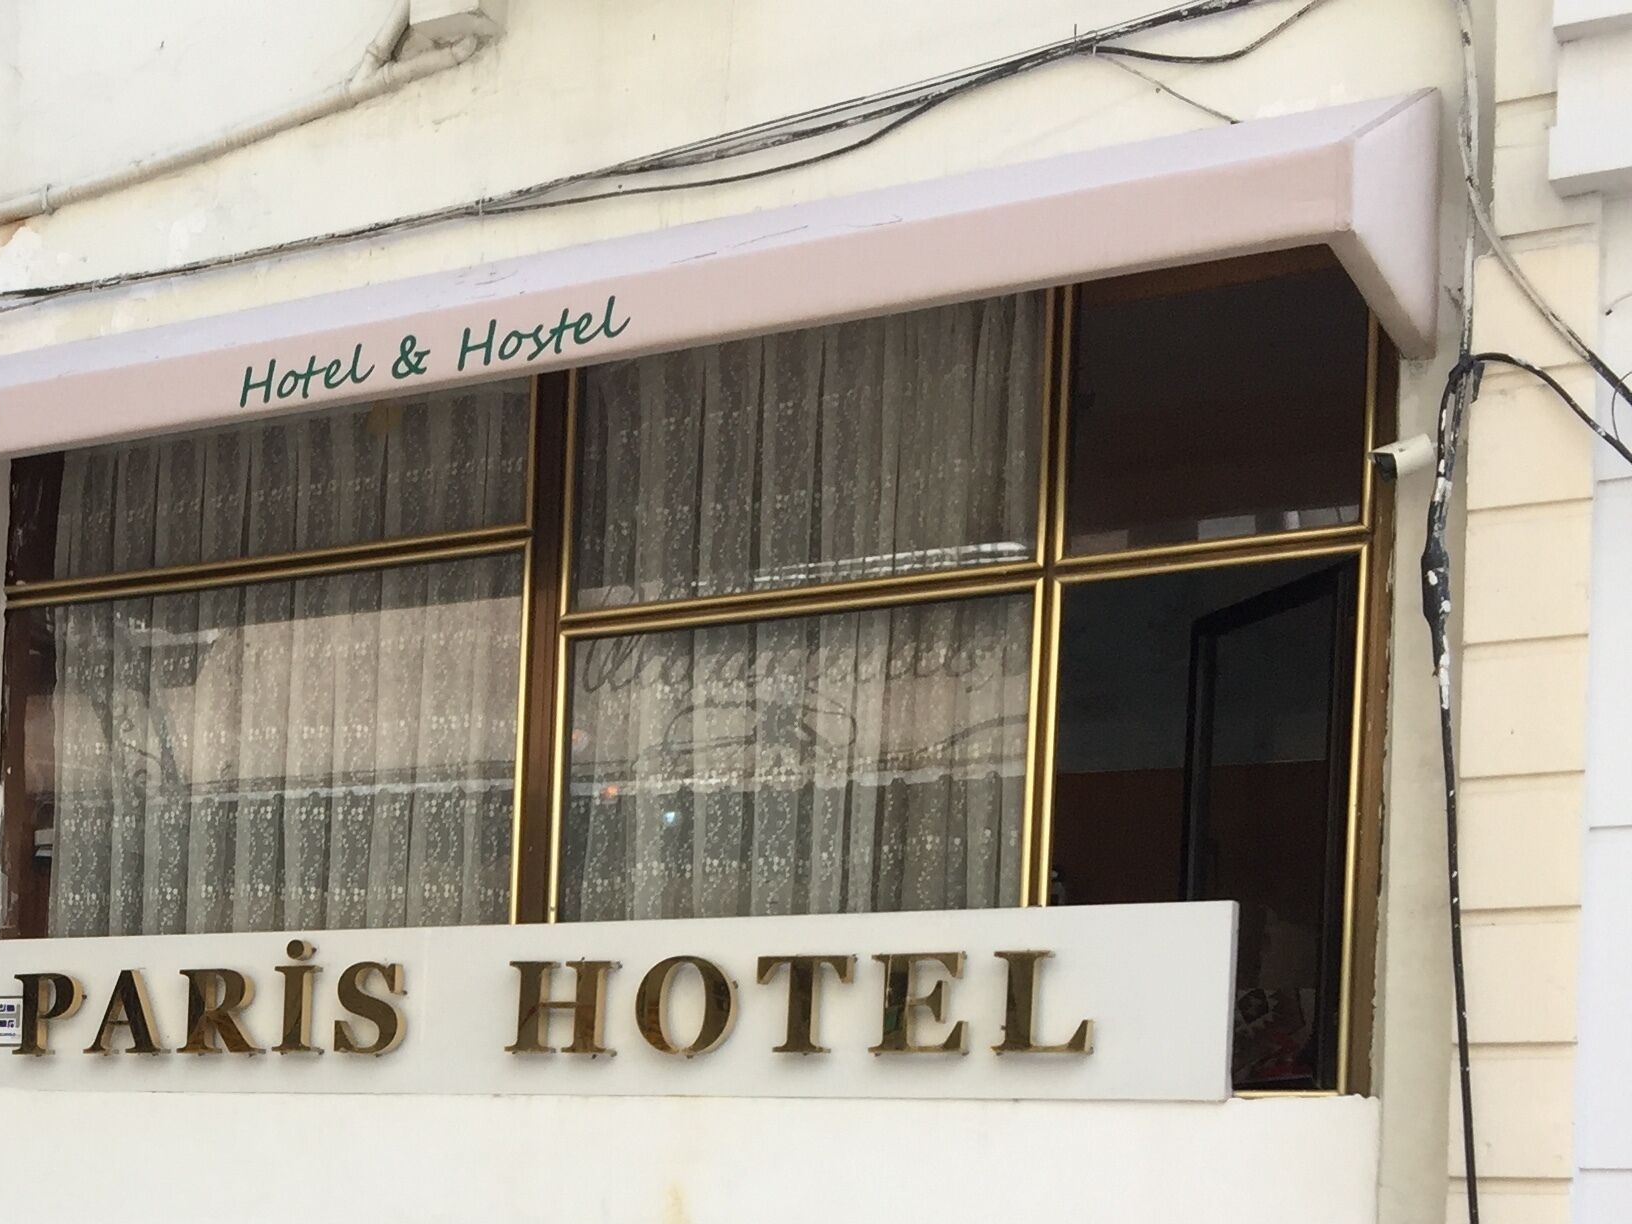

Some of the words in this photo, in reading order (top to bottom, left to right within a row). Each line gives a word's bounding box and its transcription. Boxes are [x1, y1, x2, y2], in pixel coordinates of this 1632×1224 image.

[239, 343, 375, 408] Hotel
[391, 334, 431, 379] &
[457, 295, 631, 371] Hostel
[13, 938, 407, 1058] PARİS
[504, 949, 1095, 1059] HOTEL
